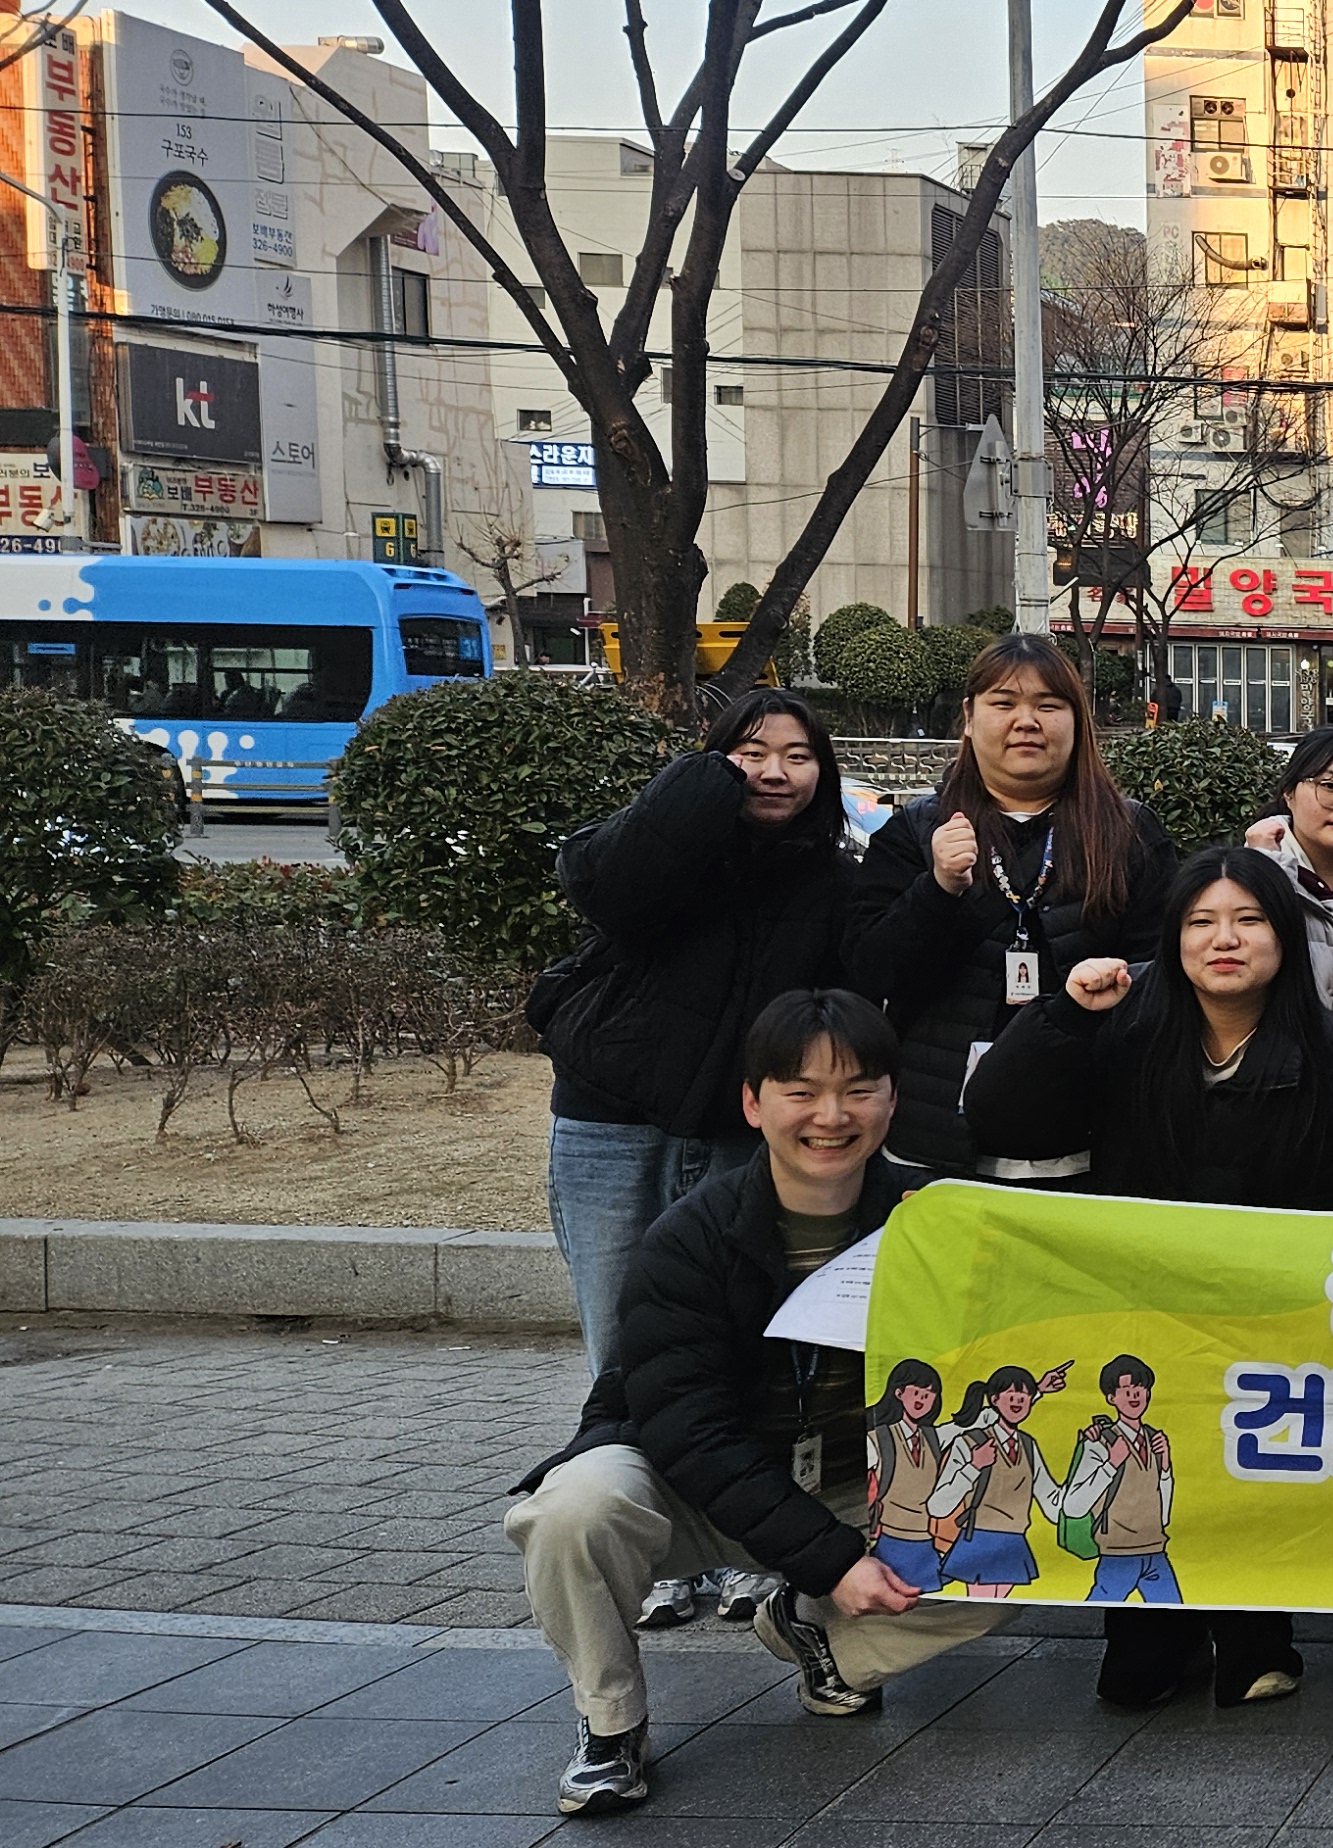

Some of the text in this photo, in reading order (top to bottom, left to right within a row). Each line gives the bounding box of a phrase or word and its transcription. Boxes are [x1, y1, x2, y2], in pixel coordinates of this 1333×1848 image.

[46, 54, 82, 212] 부동산
[176, 123, 192, 139] 153
[161, 138, 209, 166] 구포국수
[252, 237, 293, 258] 326-4900
[176, 377, 216, 430] kt
[271, 440, 316, 469] 스토어
[167, 474, 260, 506] 보배 부동산
[386, 541, 395, 556] 6
